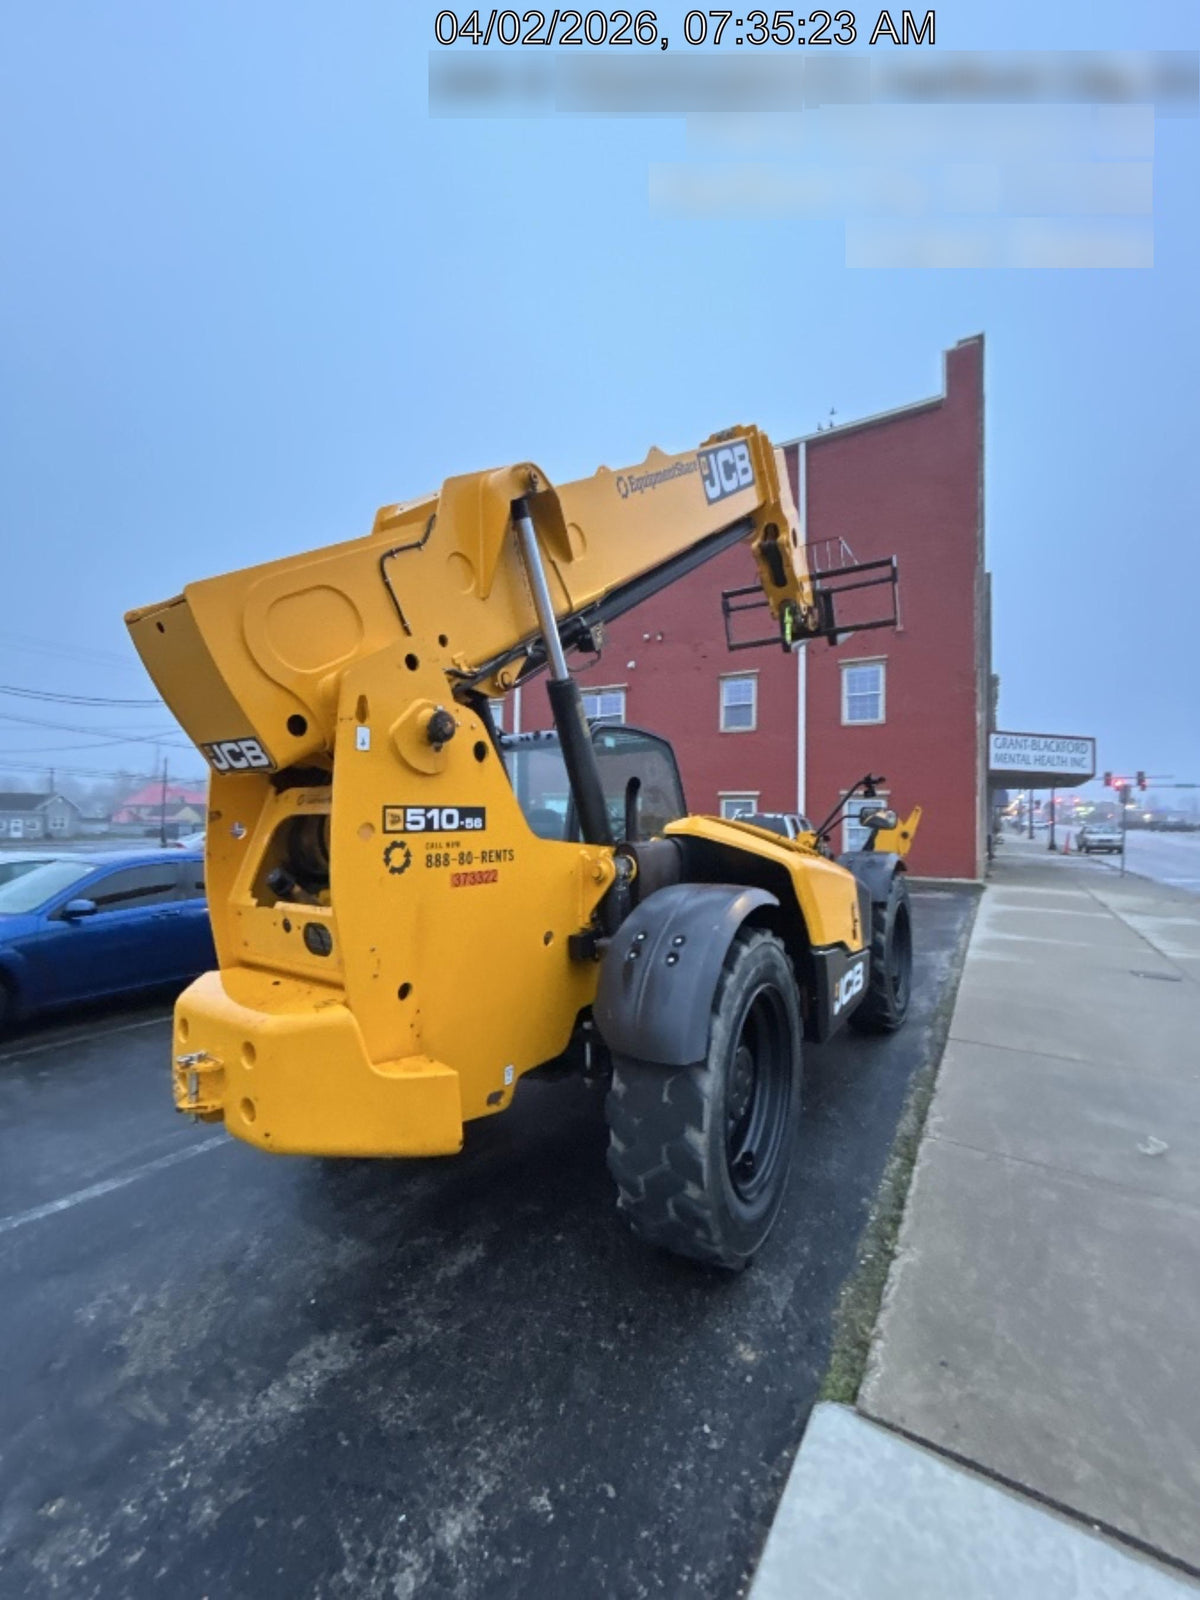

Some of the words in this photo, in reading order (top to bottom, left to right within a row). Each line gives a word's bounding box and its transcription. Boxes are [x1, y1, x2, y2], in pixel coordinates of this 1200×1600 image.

[704, 444, 753, 500] JCB
[211, 738, 270, 770] JCB
[993, 737, 1089, 754] GRANT-BLACKFORD
[994, 753, 1032, 765] MENTAL
[1033, 754, 1068, 767] HEALTH
[425, 842, 443, 850] CALL
[426, 849, 515, 868] 888-80-RENTS
[833, 961, 864, 1016] JCB
